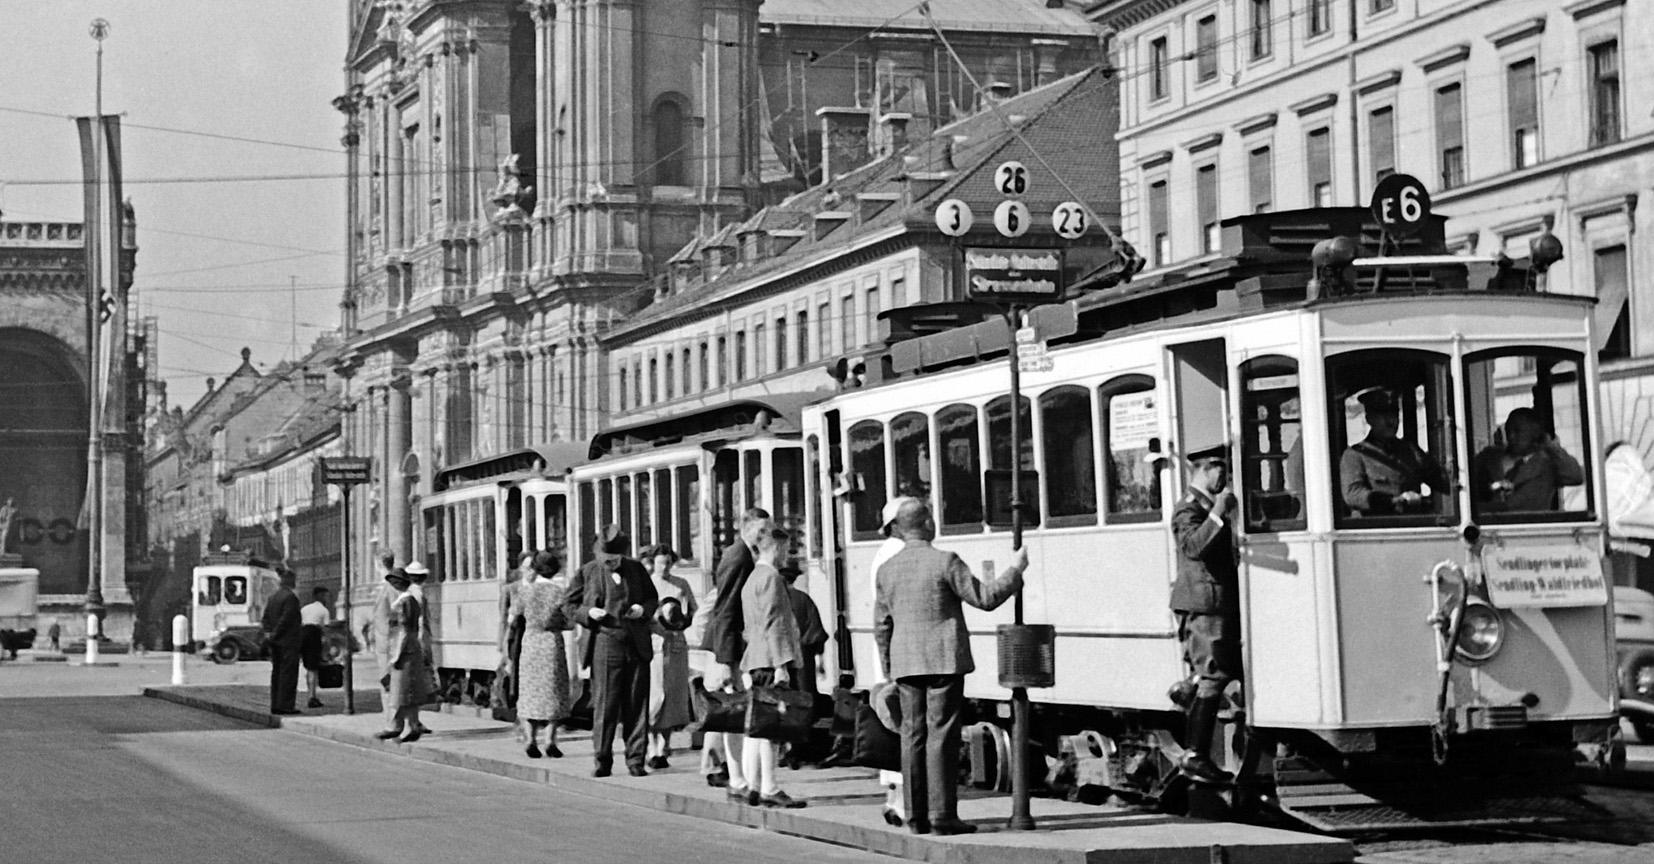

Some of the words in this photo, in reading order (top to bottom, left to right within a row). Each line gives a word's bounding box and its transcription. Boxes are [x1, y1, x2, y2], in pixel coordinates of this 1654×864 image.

[1002, 166, 1026, 194] 26
[950, 204, 961, 231] 3
[1008, 205, 1019, 232] 6
[1381, 186, 1422, 224] E6
[1058, 208, 1086, 234] 23
